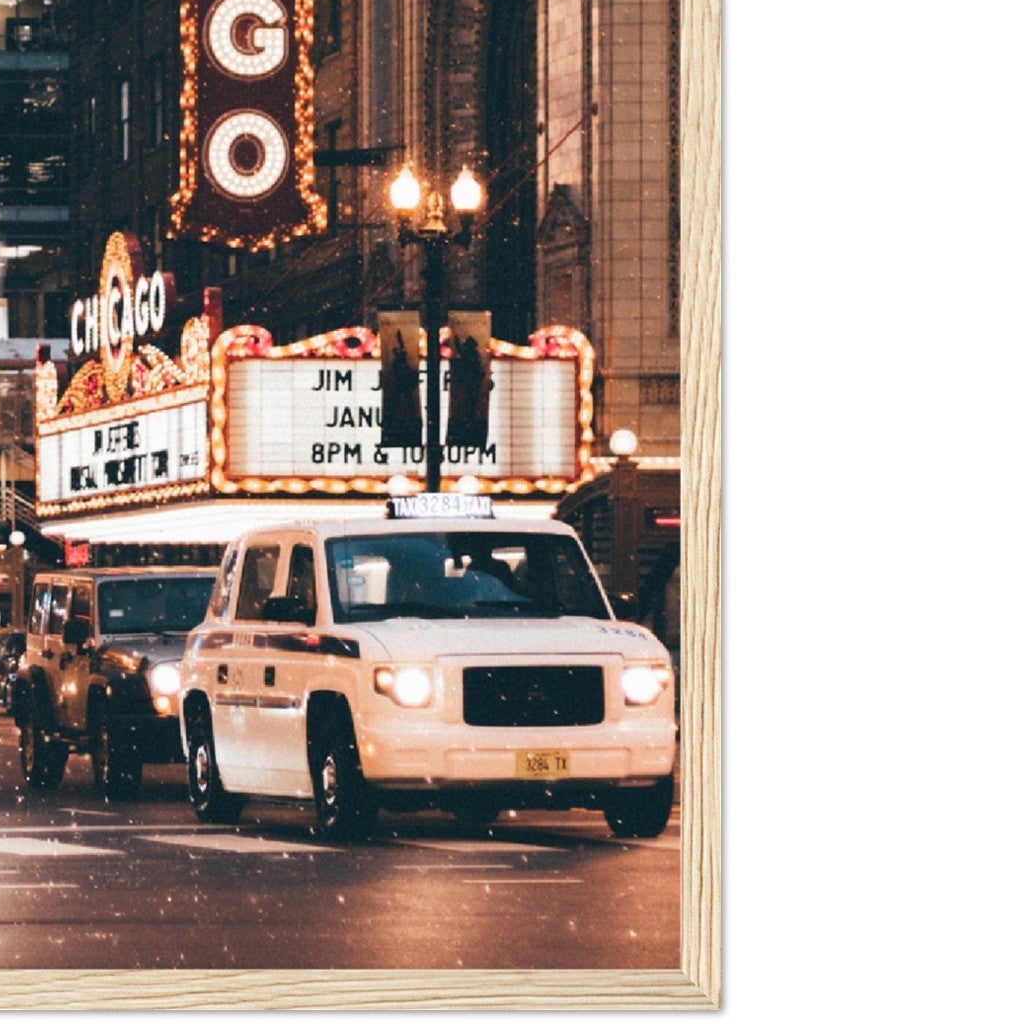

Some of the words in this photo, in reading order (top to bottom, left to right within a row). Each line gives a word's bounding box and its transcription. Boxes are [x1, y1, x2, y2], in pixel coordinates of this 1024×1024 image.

[71, 270, 166, 356] CHICAGO
[312, 369, 352, 391] JIM
[312, 443, 362, 464] 8PM
[419, 496, 461, 513] 3284
